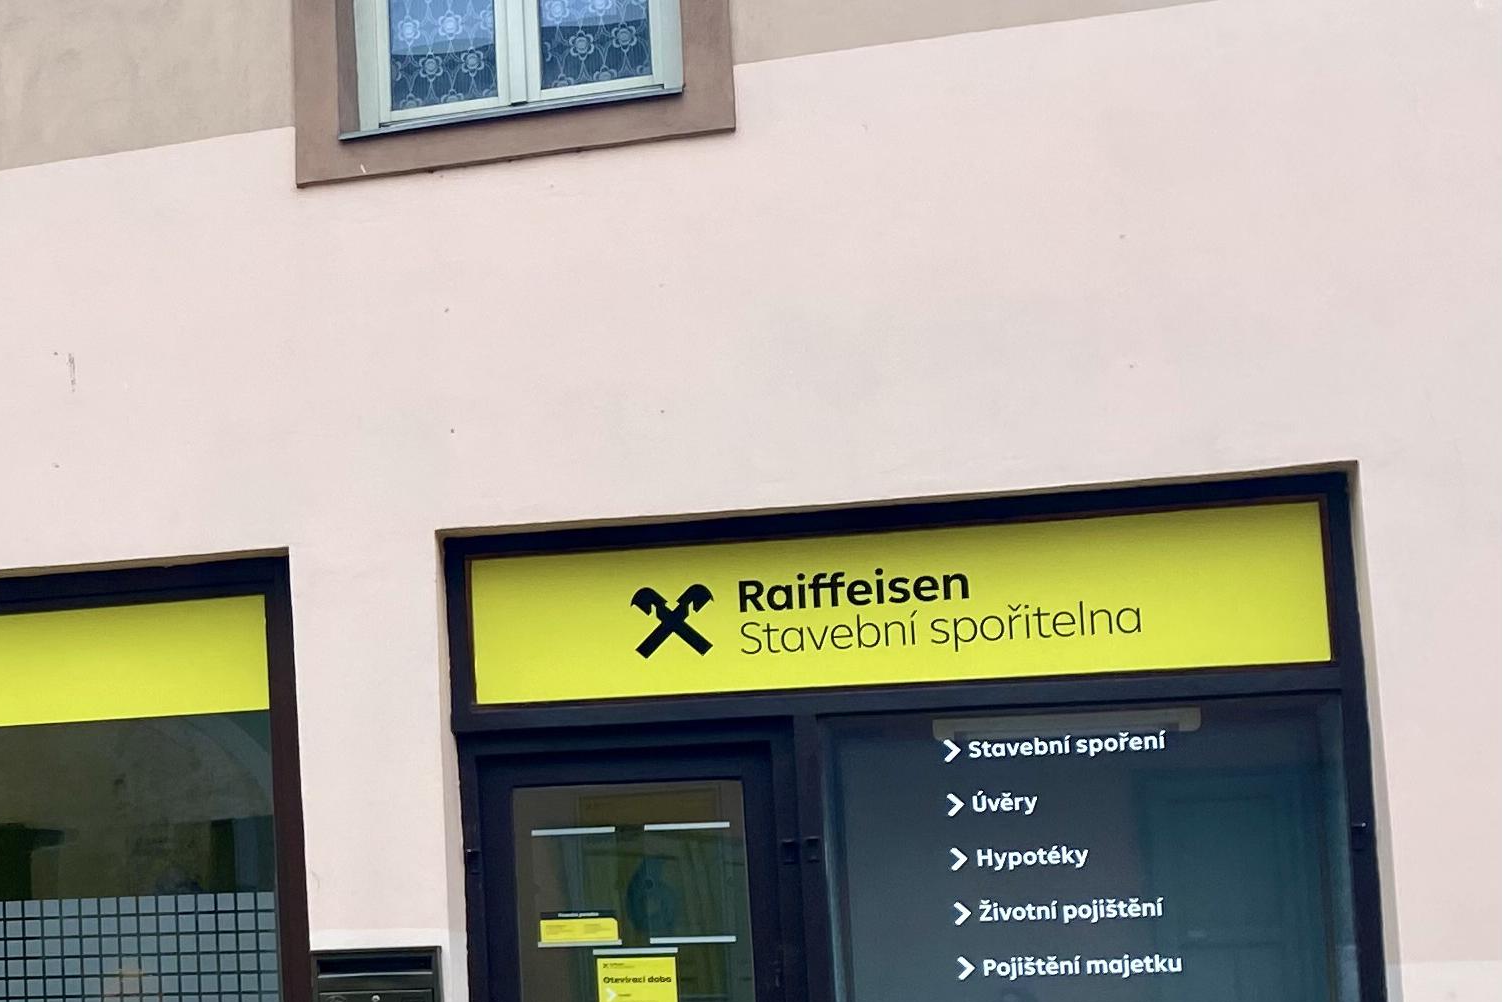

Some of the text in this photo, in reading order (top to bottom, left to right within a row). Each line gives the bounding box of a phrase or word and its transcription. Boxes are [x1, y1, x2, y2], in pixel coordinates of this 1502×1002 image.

[738, 567, 970, 613] Raiffeisen
[739, 600, 1143, 655] Stavební spořitelna
[968, 729, 1166, 759] Stavební spoření
[971, 790, 1038, 816] Úvěry
[976, 845, 1089, 872] Hypotéky
[978, 896, 1164, 924] Životní pojištění
[982, 953, 1183, 981] Pojištění majetku
